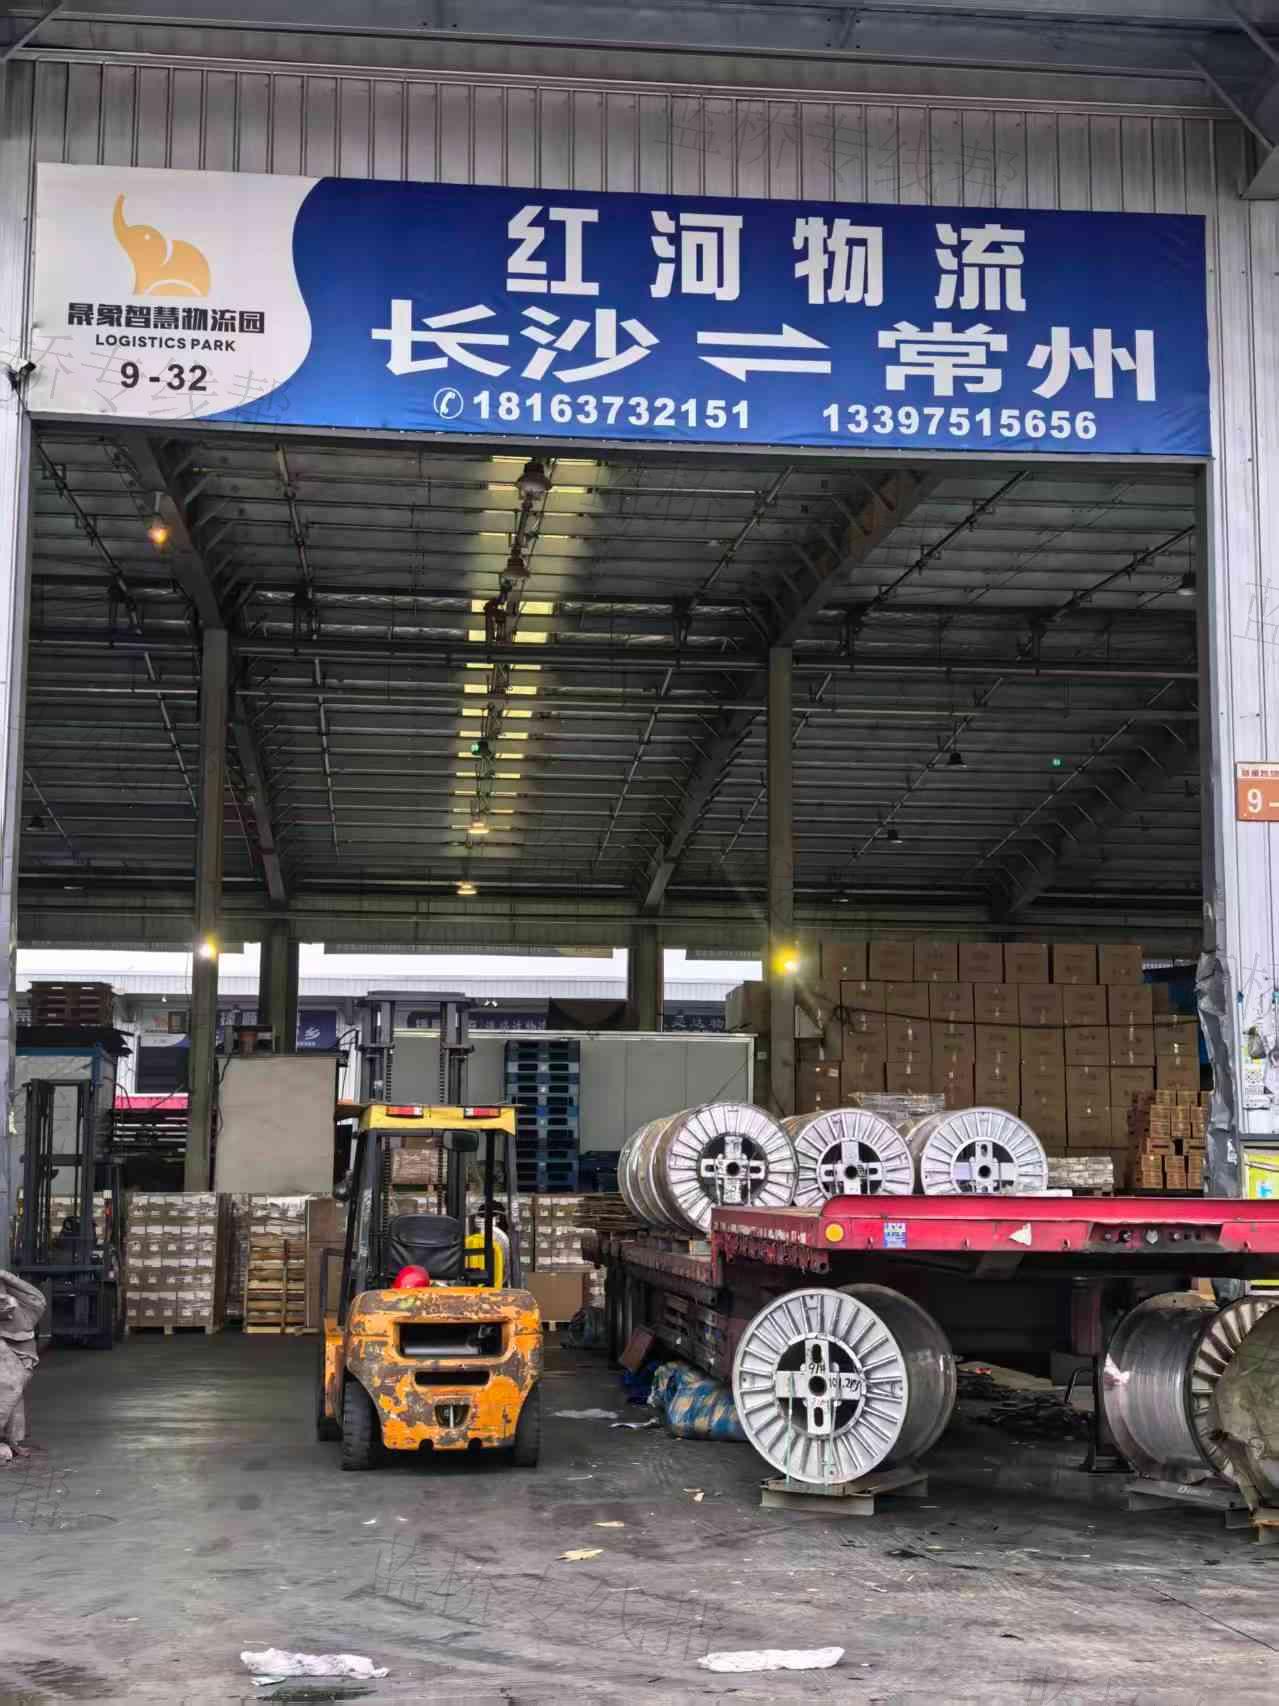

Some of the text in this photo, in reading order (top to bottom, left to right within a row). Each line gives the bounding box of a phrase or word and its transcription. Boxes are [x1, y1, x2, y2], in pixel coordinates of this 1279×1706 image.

[506, 205, 1026, 313] 红河物流
[68, 302, 265, 334] 晟象智慧物流园
[95, 334, 236, 352] LOGISTICS PARK
[371, 300, 1156, 402] 长沙 常州
[120, 361, 207, 392] 9-32
[473, 391, 1098, 440] 18163732151 13397515656
